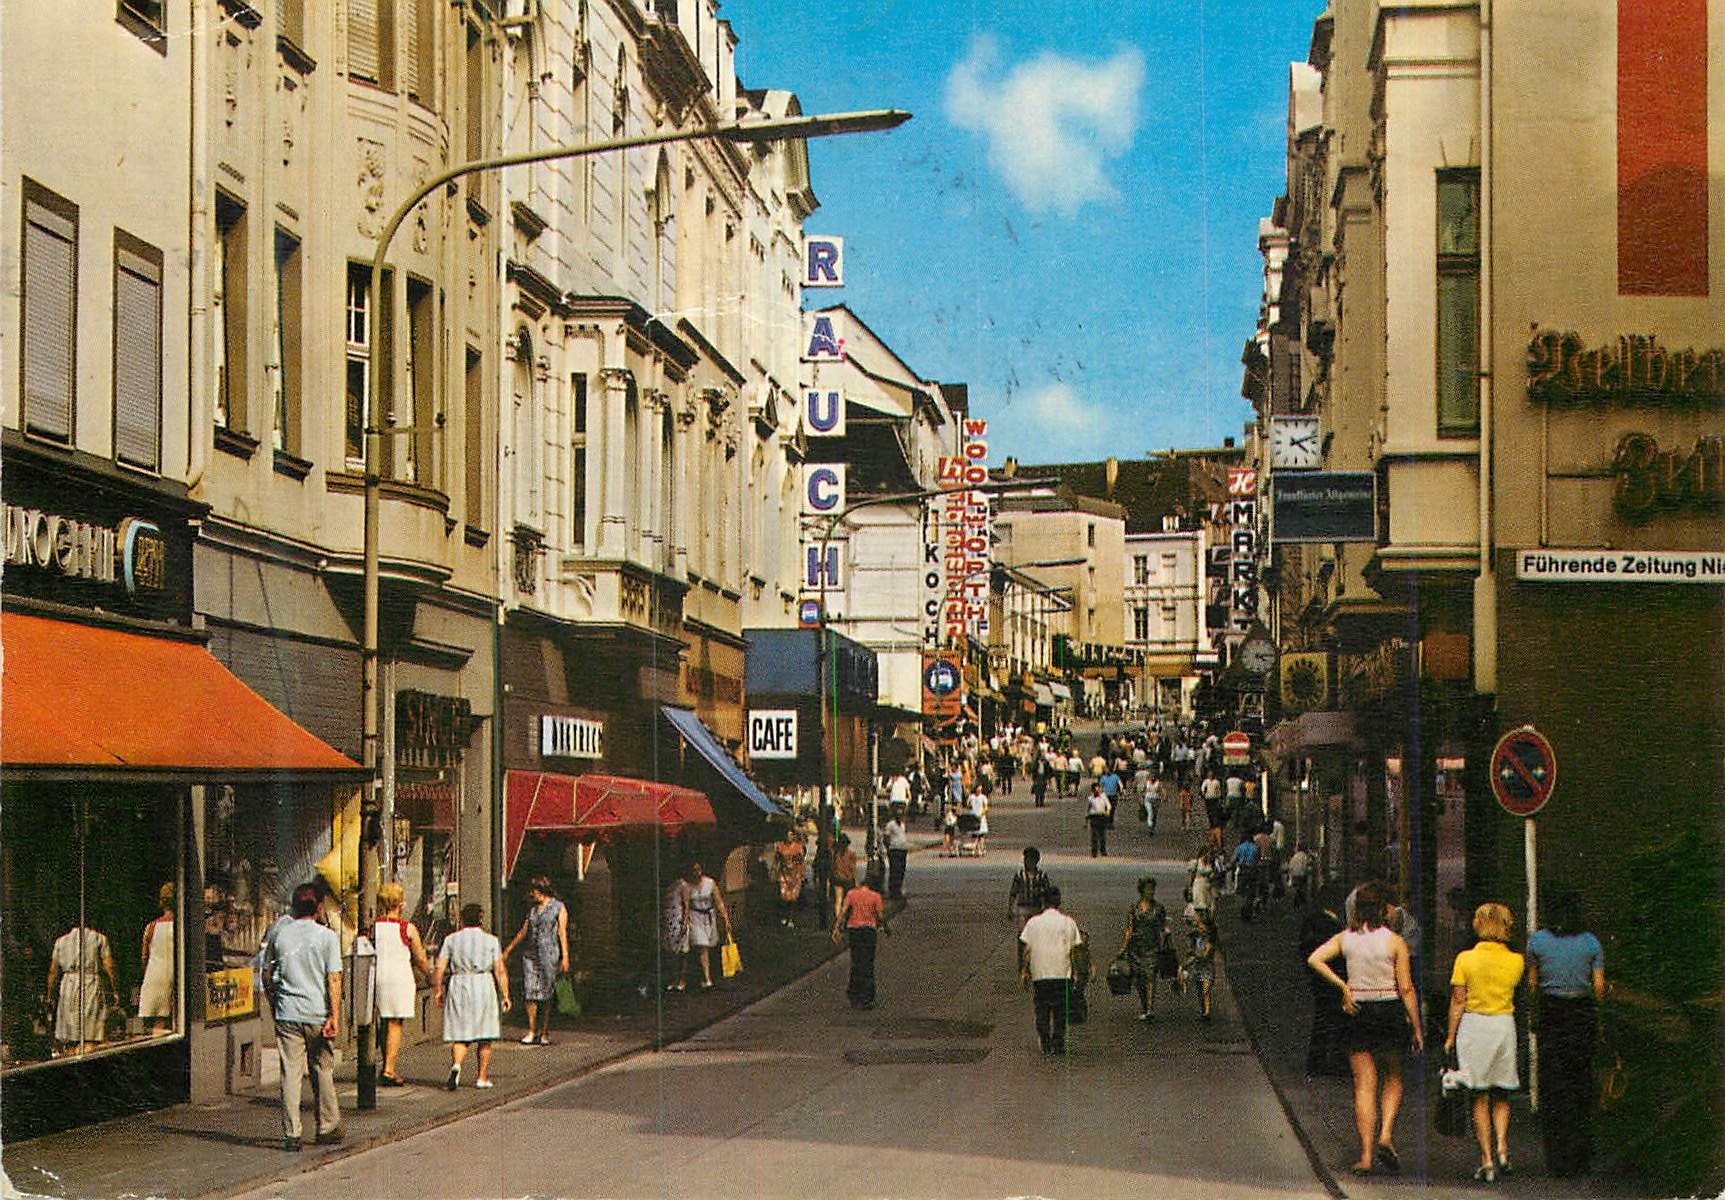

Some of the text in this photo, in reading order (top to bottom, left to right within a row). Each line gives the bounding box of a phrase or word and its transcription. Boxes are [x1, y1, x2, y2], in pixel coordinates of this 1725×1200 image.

[808, 241, 839, 586] RAUCH
[965, 420, 986, 619] WOOLWORTH
[1233, 502, 1254, 630] MARKT
[1524, 556, 1724, 578] Führende Zeitung Ni
[925, 543, 939, 644] KOCH
[752, 718, 792, 751] CAFE
